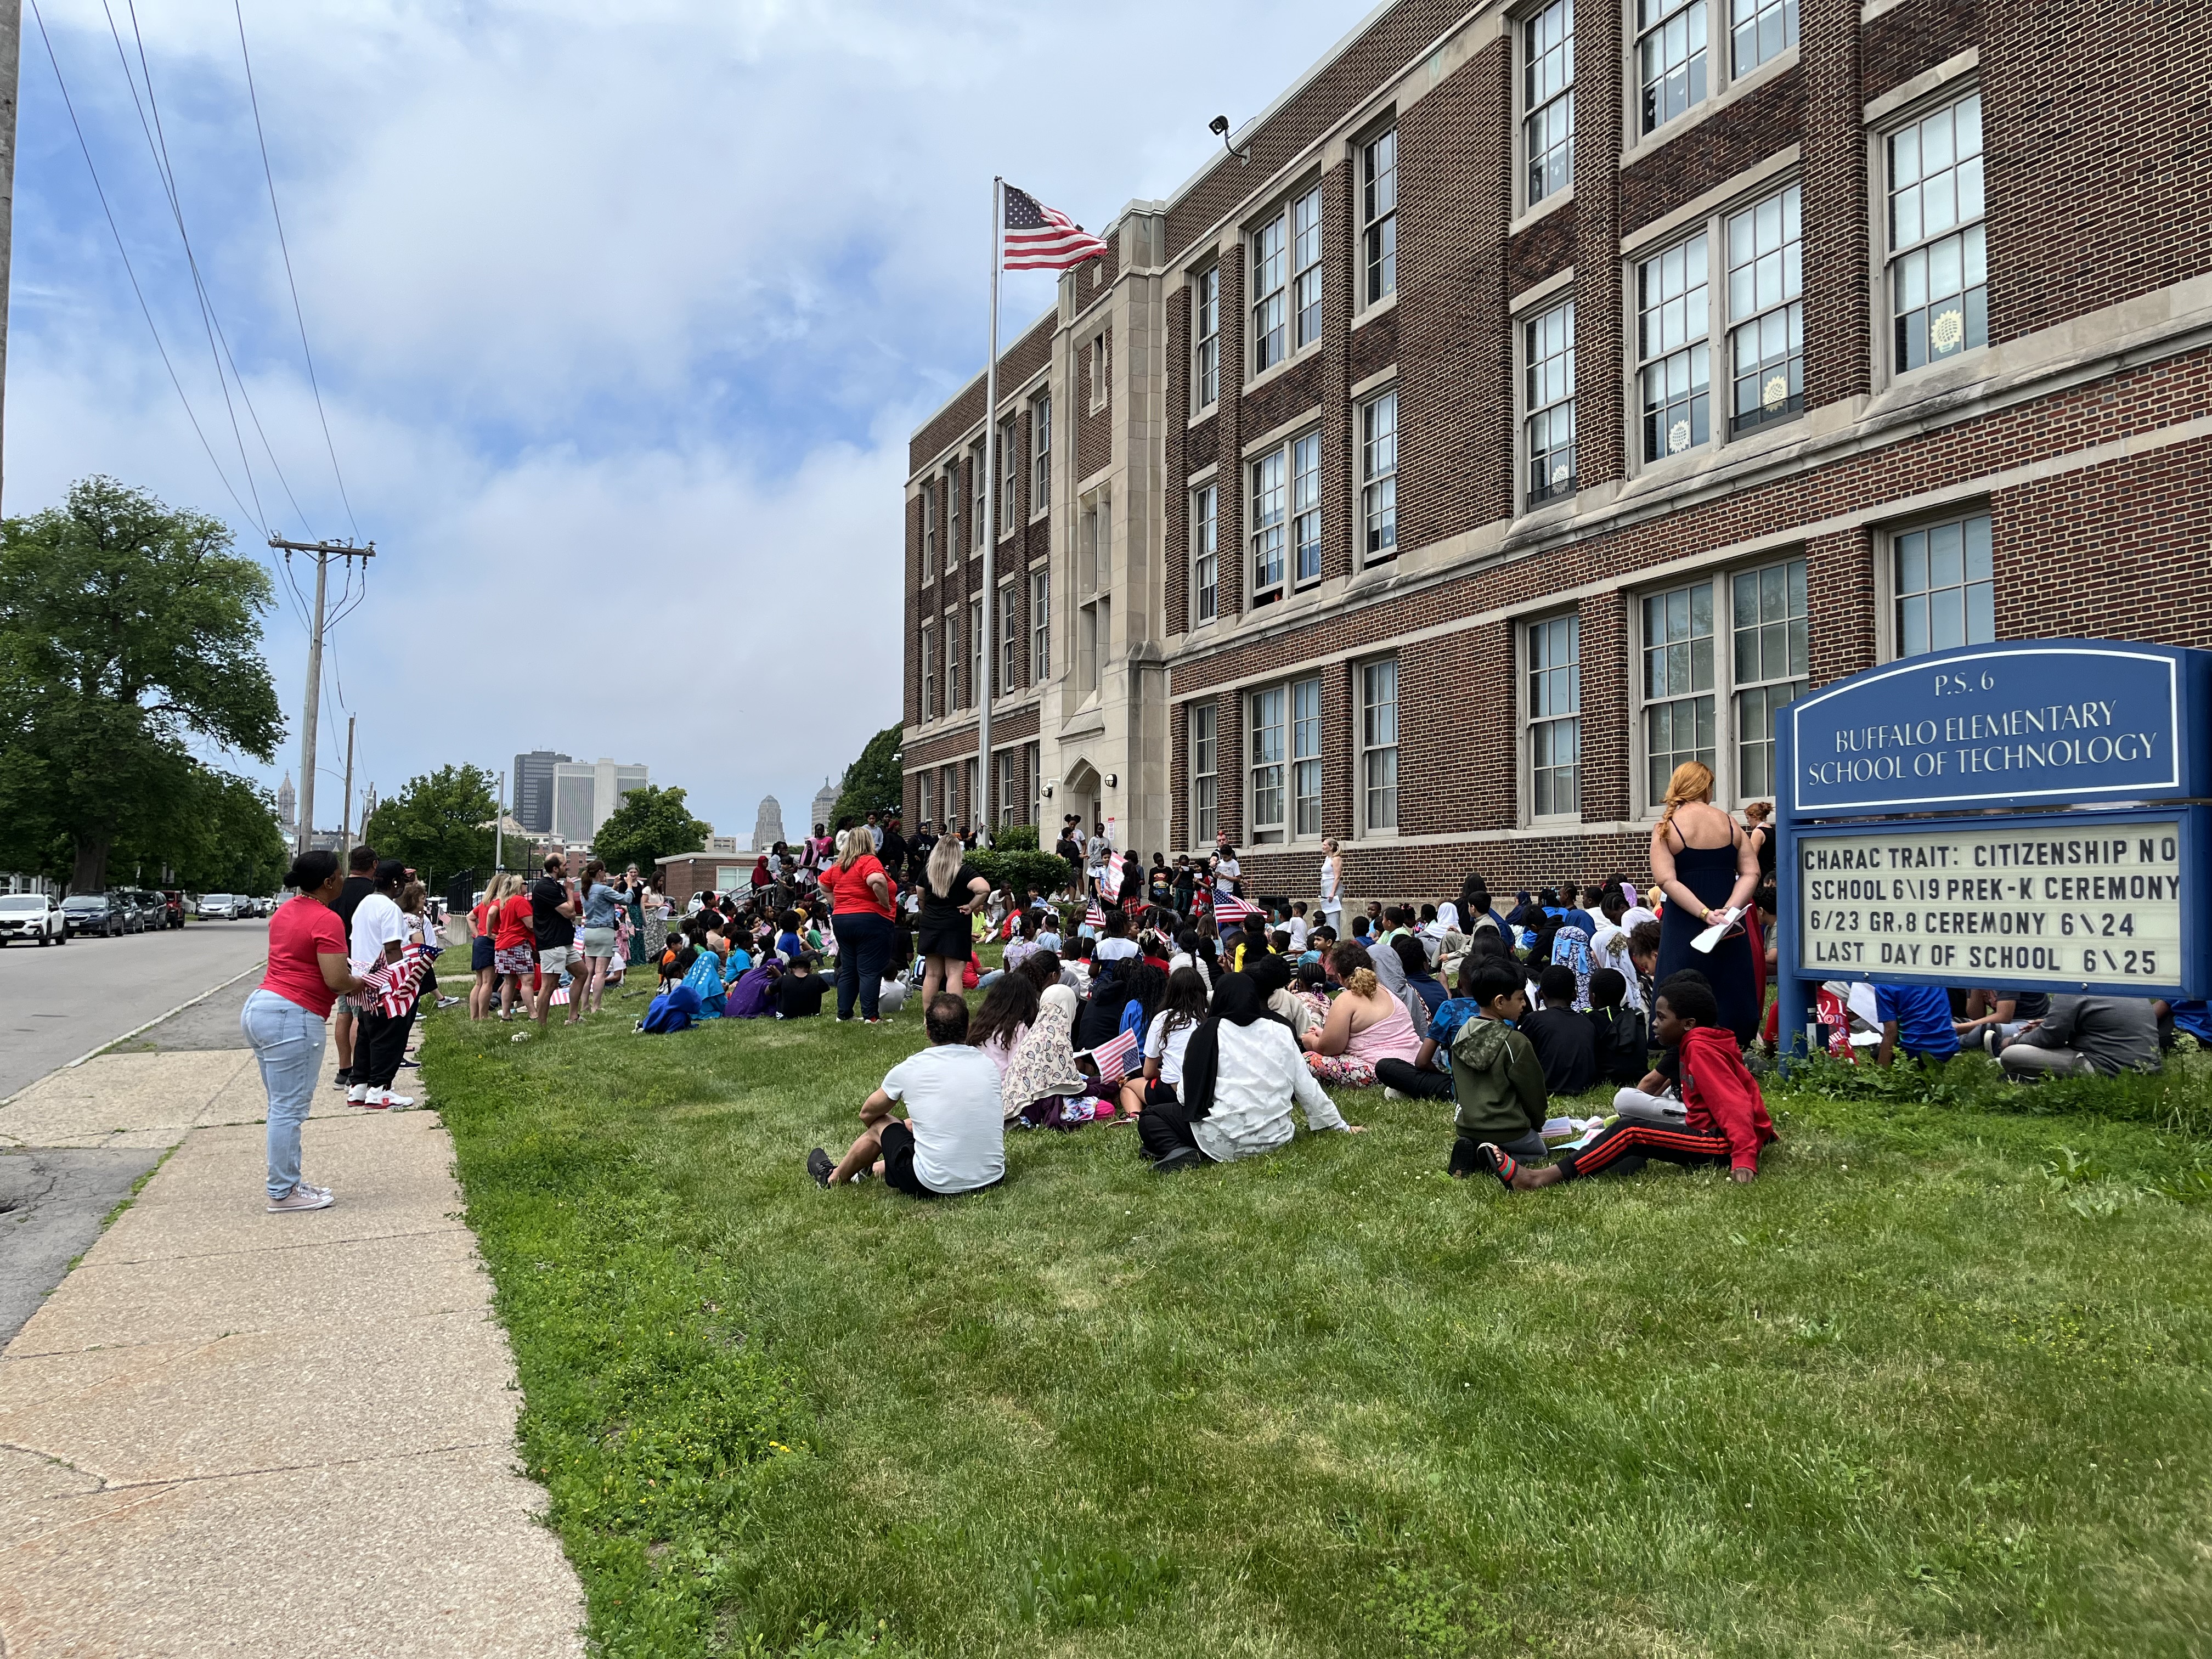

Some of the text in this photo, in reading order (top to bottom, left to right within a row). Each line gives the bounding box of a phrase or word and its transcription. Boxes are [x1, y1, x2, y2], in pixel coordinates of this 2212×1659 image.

[1935, 669, 1994, 696] P.S. 6
[1836, 699, 2117, 753] BUFFALO ELEMENTARY
[1809, 732, 2157, 786] SCHOOL OF TECHNOLOGY
[1805, 837, 2176, 871] CHARAC TRAIT: CITIZENSHIP NO
[1812, 875, 2180, 901] SCHOOL 6\19 PREK-K CEREMONY
[1811, 910, 1859, 931] 6/23
[1926, 912, 2046, 935] CEREMONY
[2061, 912, 2134, 937] 6\24
[1816, 941, 2155, 974] LAST DAY OF SCHOOL 6\25
